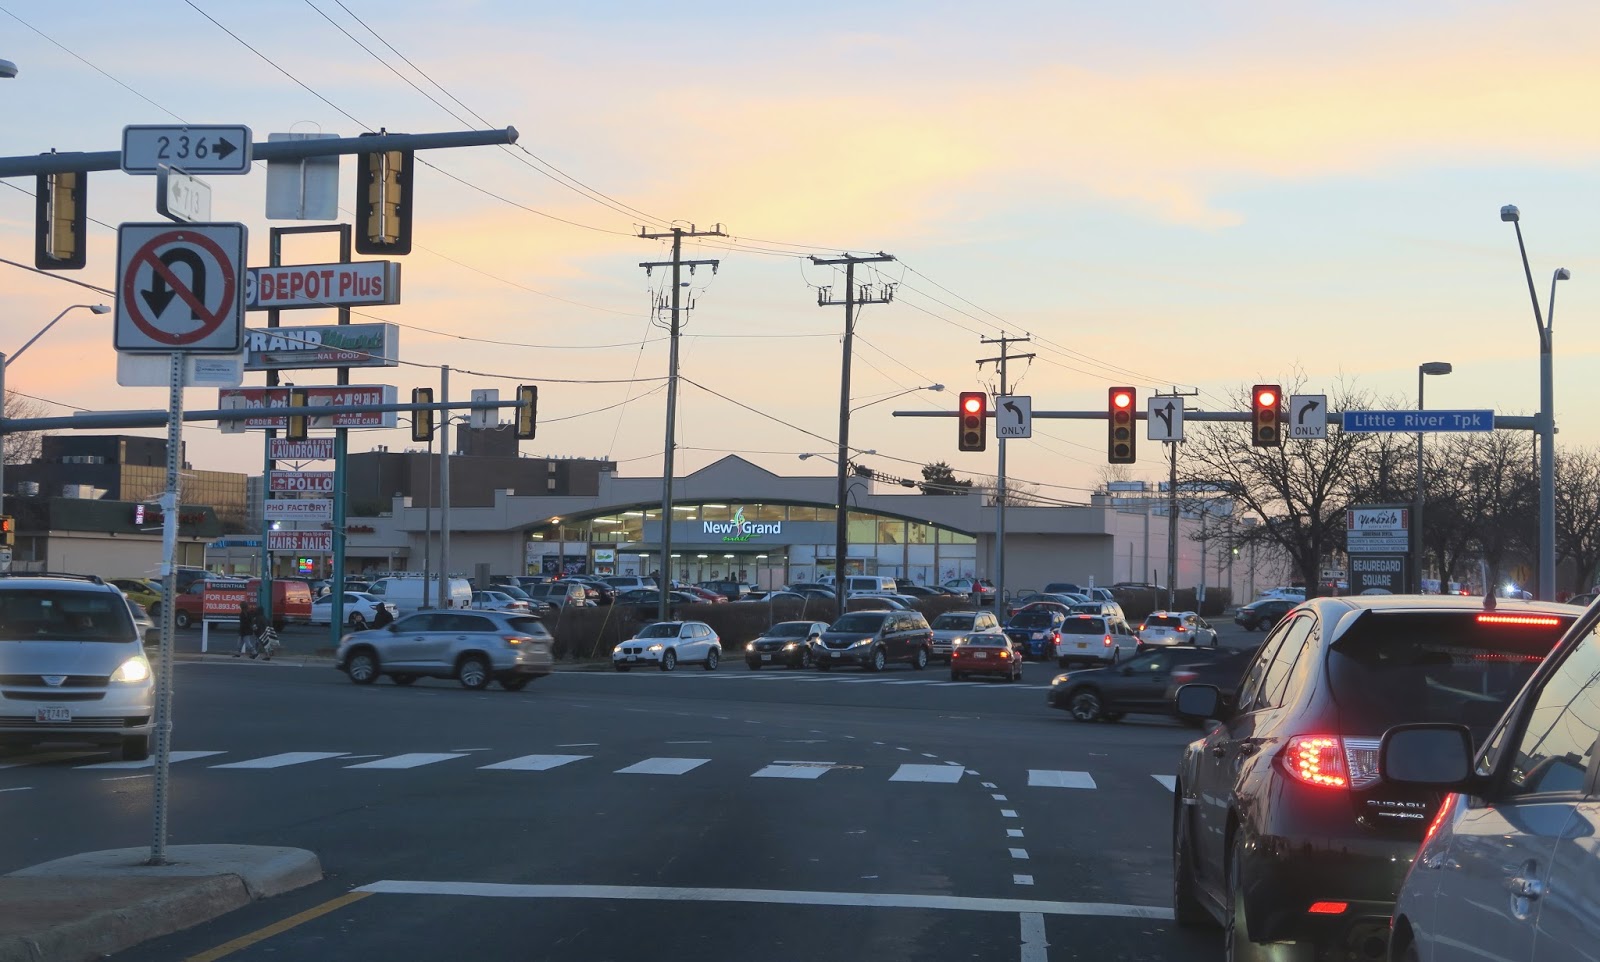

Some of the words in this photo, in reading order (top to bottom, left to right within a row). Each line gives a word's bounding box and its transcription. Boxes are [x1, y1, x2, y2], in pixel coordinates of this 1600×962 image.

[157, 136, 208, 160] 236
[184, 186, 200, 214] 713
[260, 270, 335, 300] DEPOT
[339, 271, 382, 297] Plus
[243, 330, 322, 352] RAND
[1355, 414, 1396, 427] Little
[1404, 414, 1445, 427] River
[1453, 414, 1481, 429] Tpk
[1001, 426, 1025, 435] ONLY
[1295, 427, 1321, 436] ONLY
[271, 445, 332, 458] LAUNDROMAT
[287, 477, 332, 490] POLLO
[287, 503, 327, 511] FACTORY
[703, 521, 733, 534] New
[742, 521, 781, 534] Grand
[269, 536, 298, 549] HAIRS
[302, 536, 330, 549] NAILS
[1353, 560, 1401, 572] BEAUREGARD
[1362, 574, 1392, 586] SQUARE
[1366, 800, 1426, 809] SUBARU
